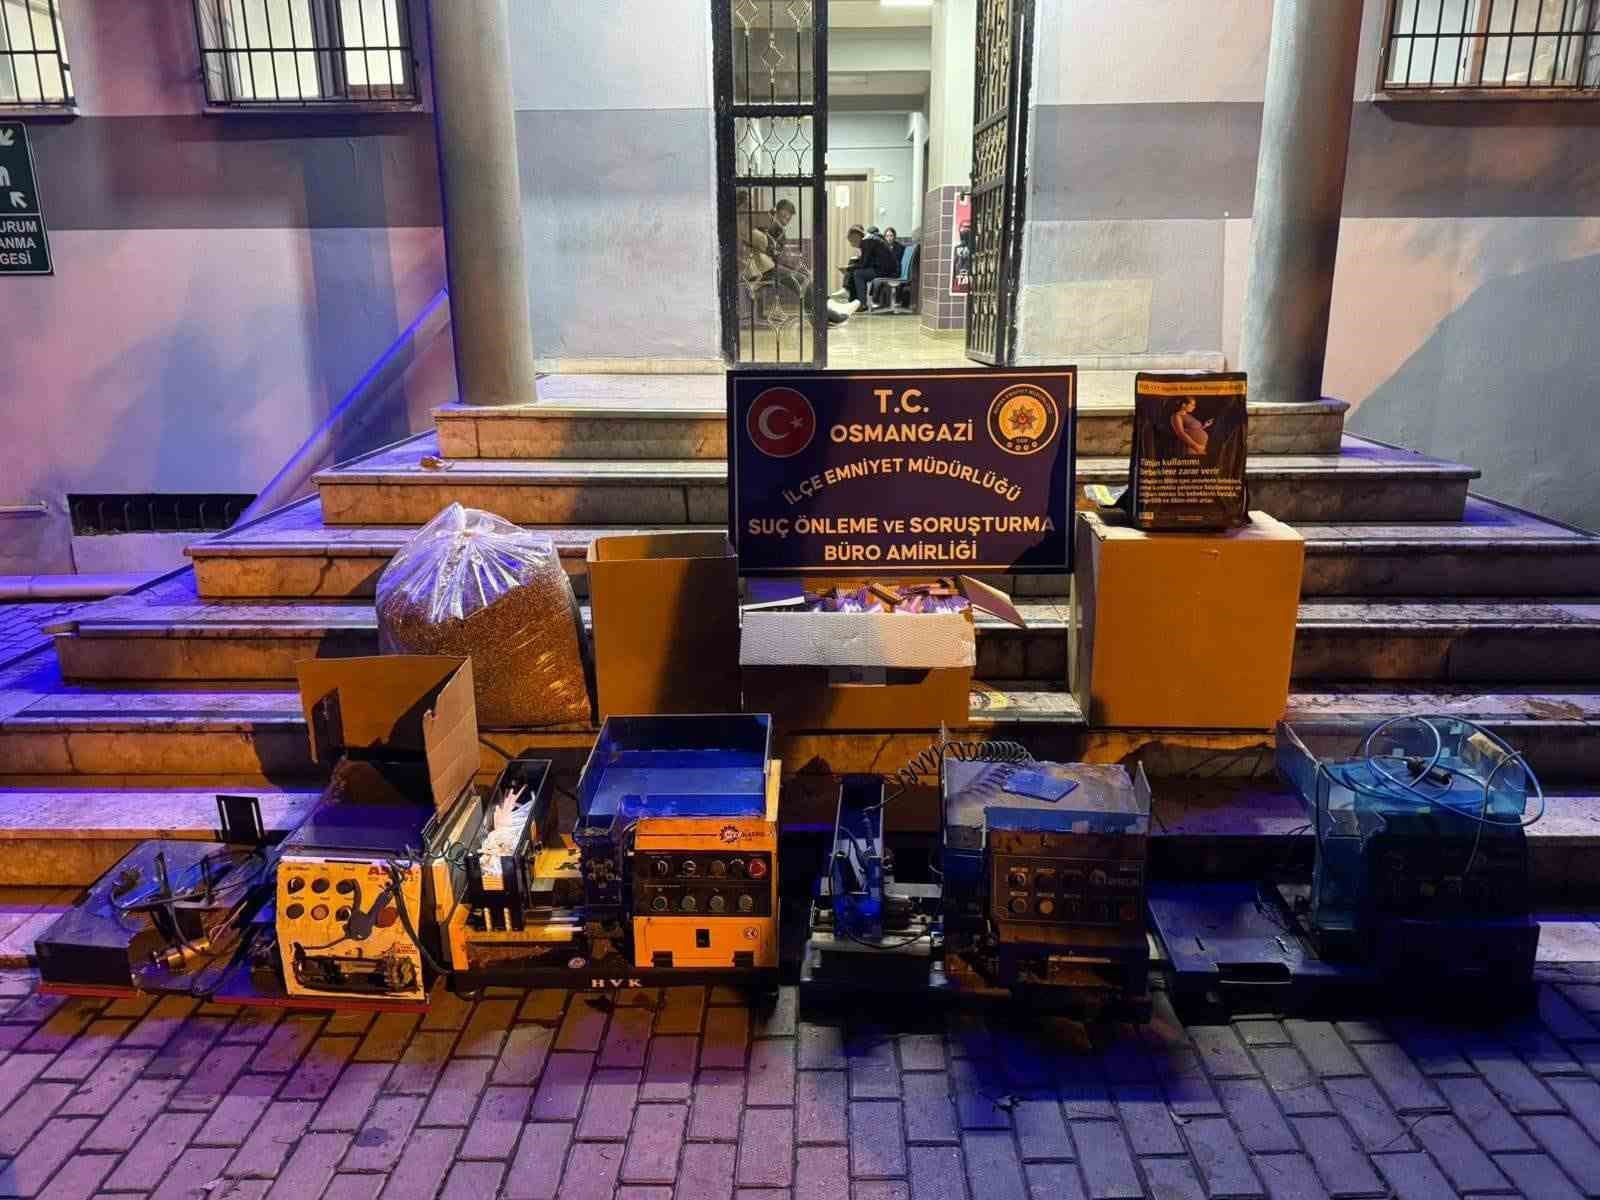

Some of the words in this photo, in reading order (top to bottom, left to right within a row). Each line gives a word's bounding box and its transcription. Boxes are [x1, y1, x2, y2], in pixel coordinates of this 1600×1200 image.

[873, 388, 929, 414] T.C.
[830, 418, 973, 444] OSMANGAZİ
[783, 474, 824, 505] İLÇE
[824, 457, 904, 485] EMNİYET
[908, 455, 1022, 502] MÜDÜRLÜĞÜ
[748, 518, 790, 538] SUÇ
[795, 515, 878, 535] ÖNLEME
[909, 516, 1055, 537] SORUŞTURMA
[824, 540, 881, 561] BÜRO
[886, 539, 977, 561] AMİRLİĞİ
